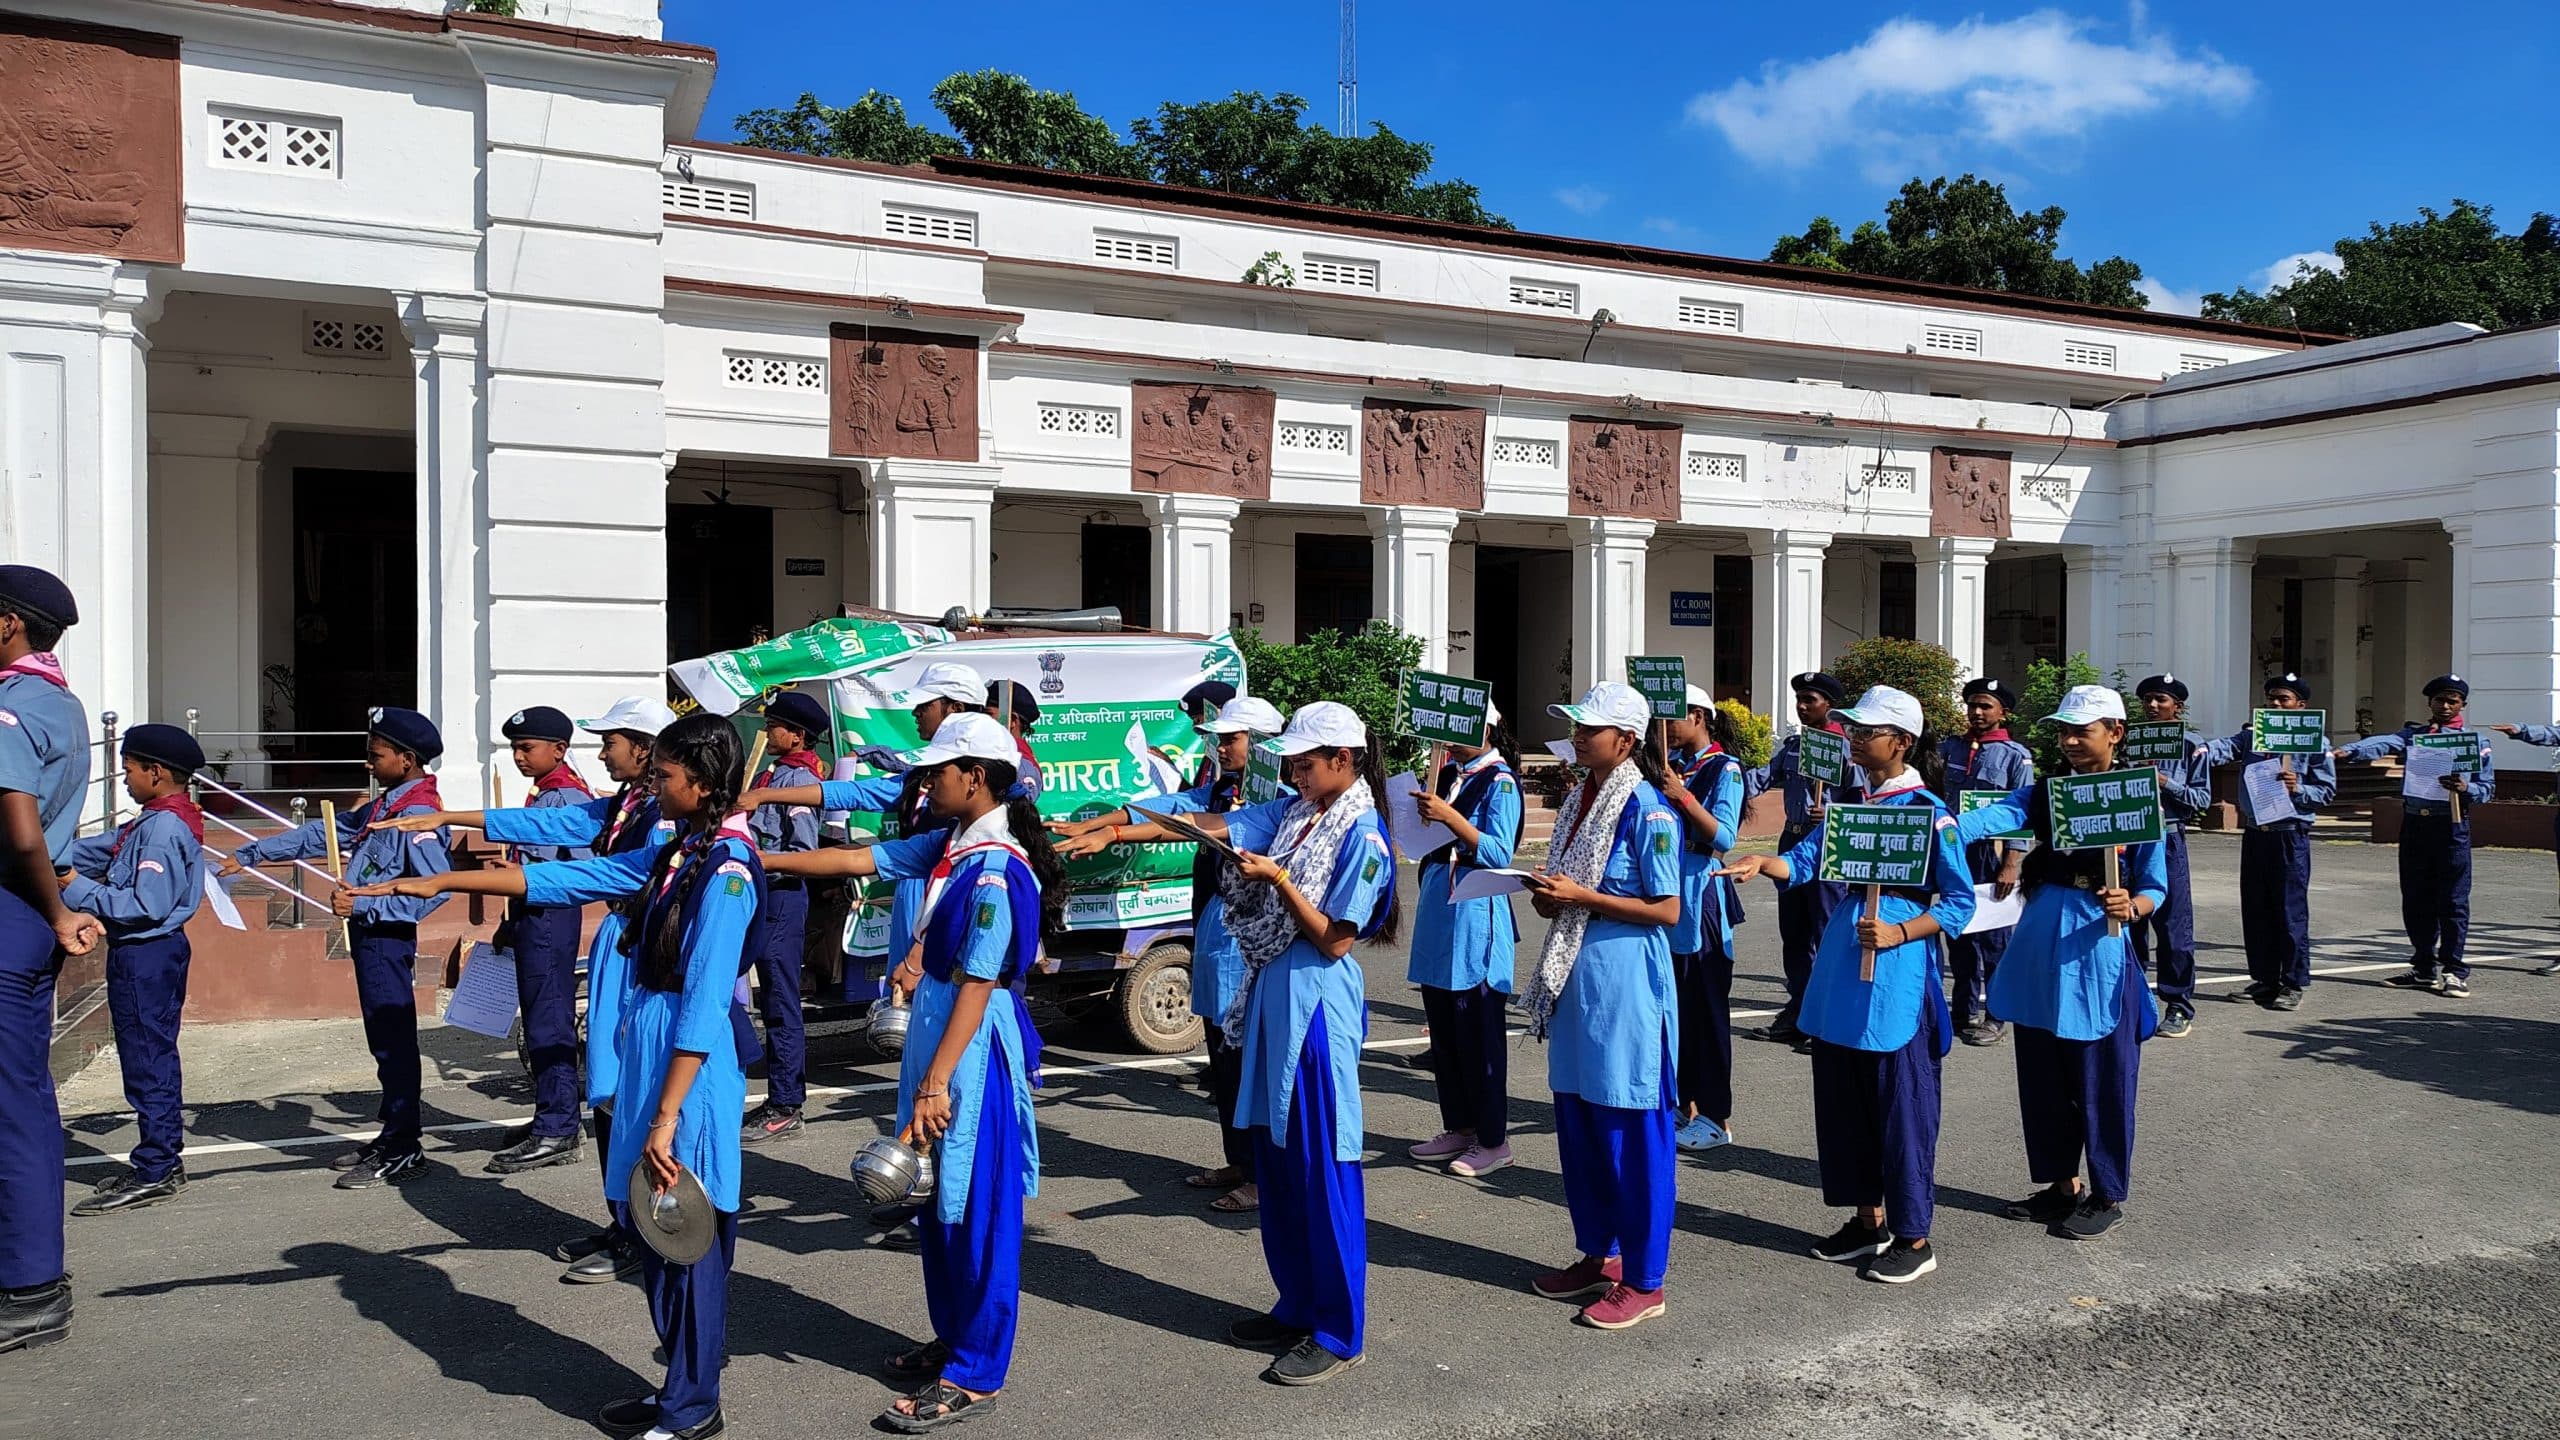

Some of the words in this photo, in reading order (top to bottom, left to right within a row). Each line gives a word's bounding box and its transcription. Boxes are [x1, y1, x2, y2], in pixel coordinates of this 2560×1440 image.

[1689, 600, 1710, 610] ROOM
[1440, 682, 1461, 707] मुक्त
[1462, 687, 1486, 711] भारत,
[1058, 704, 1125, 725] अधिकारिता
[1130, 706, 1175, 722] मंत्रालय
[1411, 707, 1447, 732] खुशहाल
[1052, 731, 1087, 743] सरकार
[1042, 758, 1121, 793] भारत
[2063, 782, 2095, 804] “नशा
[2097, 781, 2122, 808] मुक्त
[2125, 777, 2155, 800] भारत,
[2068, 814, 2112, 842] खुशहाल
[1839, 828, 1876, 850] “नशा
[1880, 833, 1909, 857] मुक्त
[1912, 829, 1927, 851] हो
[1841, 860, 1872, 878] भारत
[1118, 893, 1139, 915] पूर्वी
